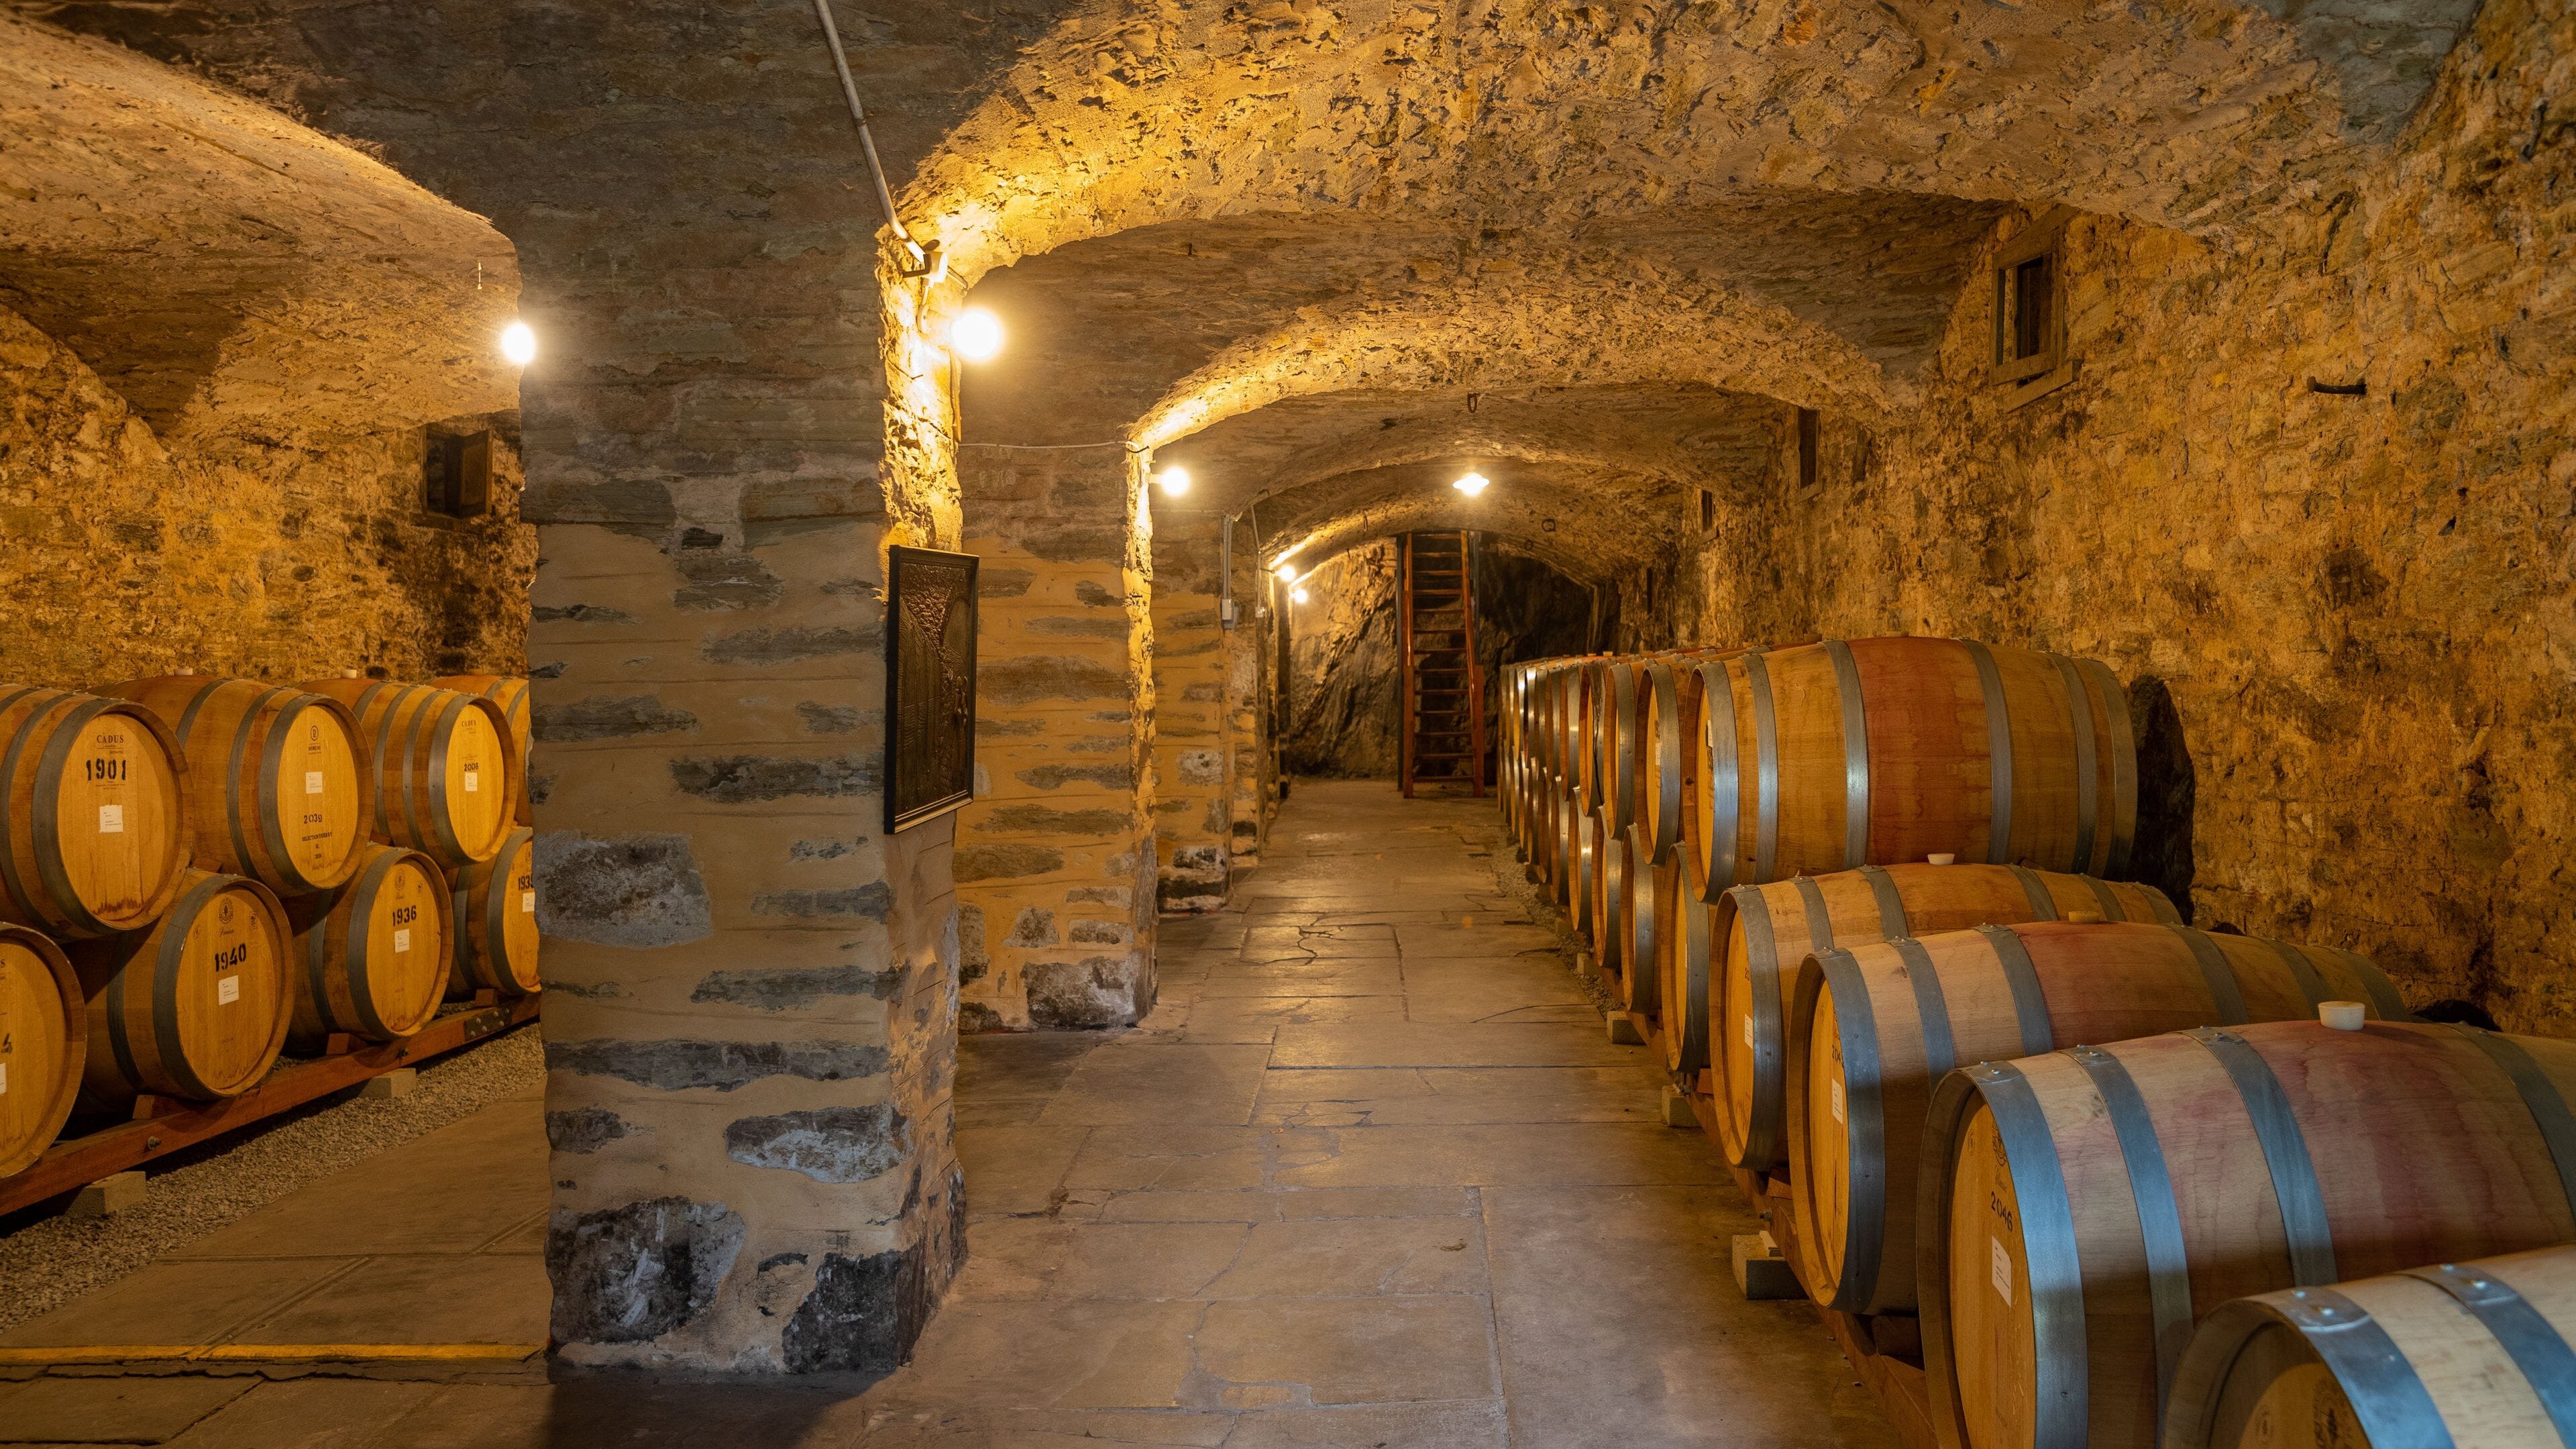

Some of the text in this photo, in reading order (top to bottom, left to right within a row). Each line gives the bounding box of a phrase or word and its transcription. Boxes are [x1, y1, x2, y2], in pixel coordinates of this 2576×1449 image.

[97, 735, 124, 743] CADUS
[86, 758, 126, 782] 1901
[304, 813, 322, 824] 2039
[392, 904, 417, 926] 1936
[215, 943, 247, 972] 1940
[1991, 1191, 2013, 1232] 2046
